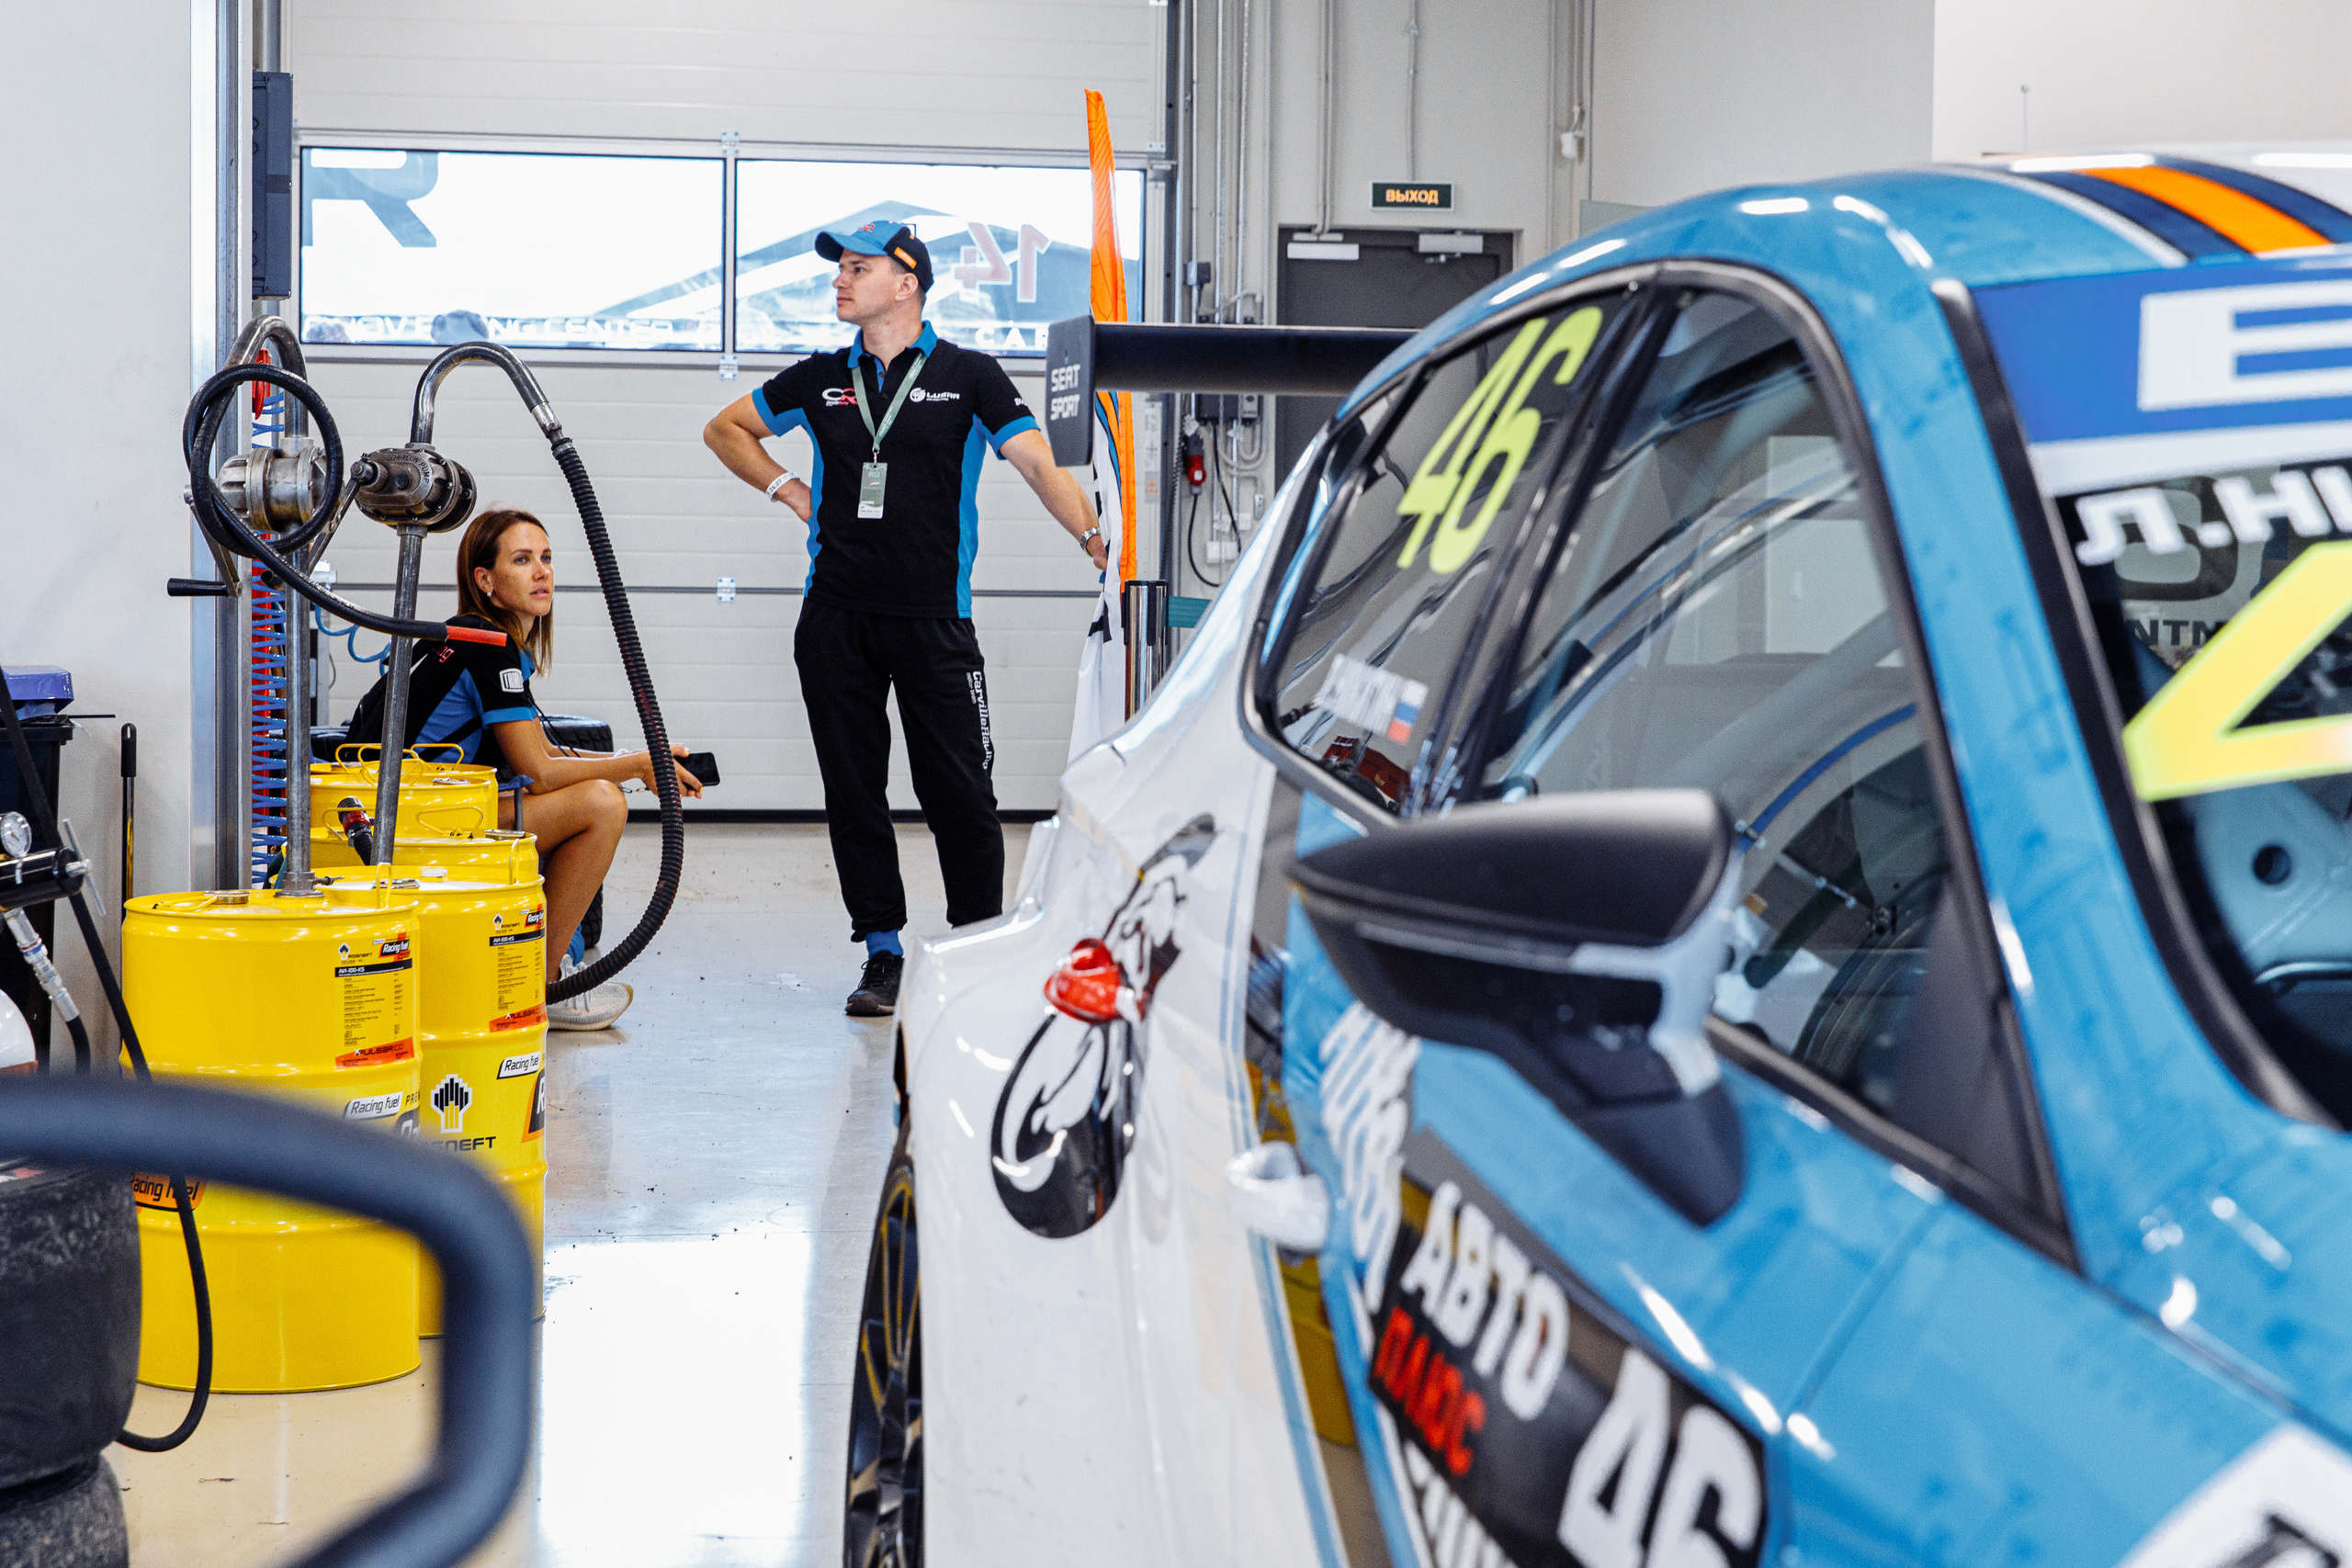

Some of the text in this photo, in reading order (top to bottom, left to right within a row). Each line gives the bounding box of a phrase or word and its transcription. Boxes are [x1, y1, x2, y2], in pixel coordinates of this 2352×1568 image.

[1385, 189, 1439, 206] ВЫХОД
[1050, 364, 1080, 392] SEAT
[1050, 394, 1080, 421] SPORT
[1396, 306, 1602, 574] 46
[382, 942, 401, 953] Racing
[504, 1055, 539, 1072] Racing fuel
[350, 1099, 383, 1115] Racing
[385, 1094, 401, 1109] fuel
[1400, 1179, 1570, 1421] АВТО
